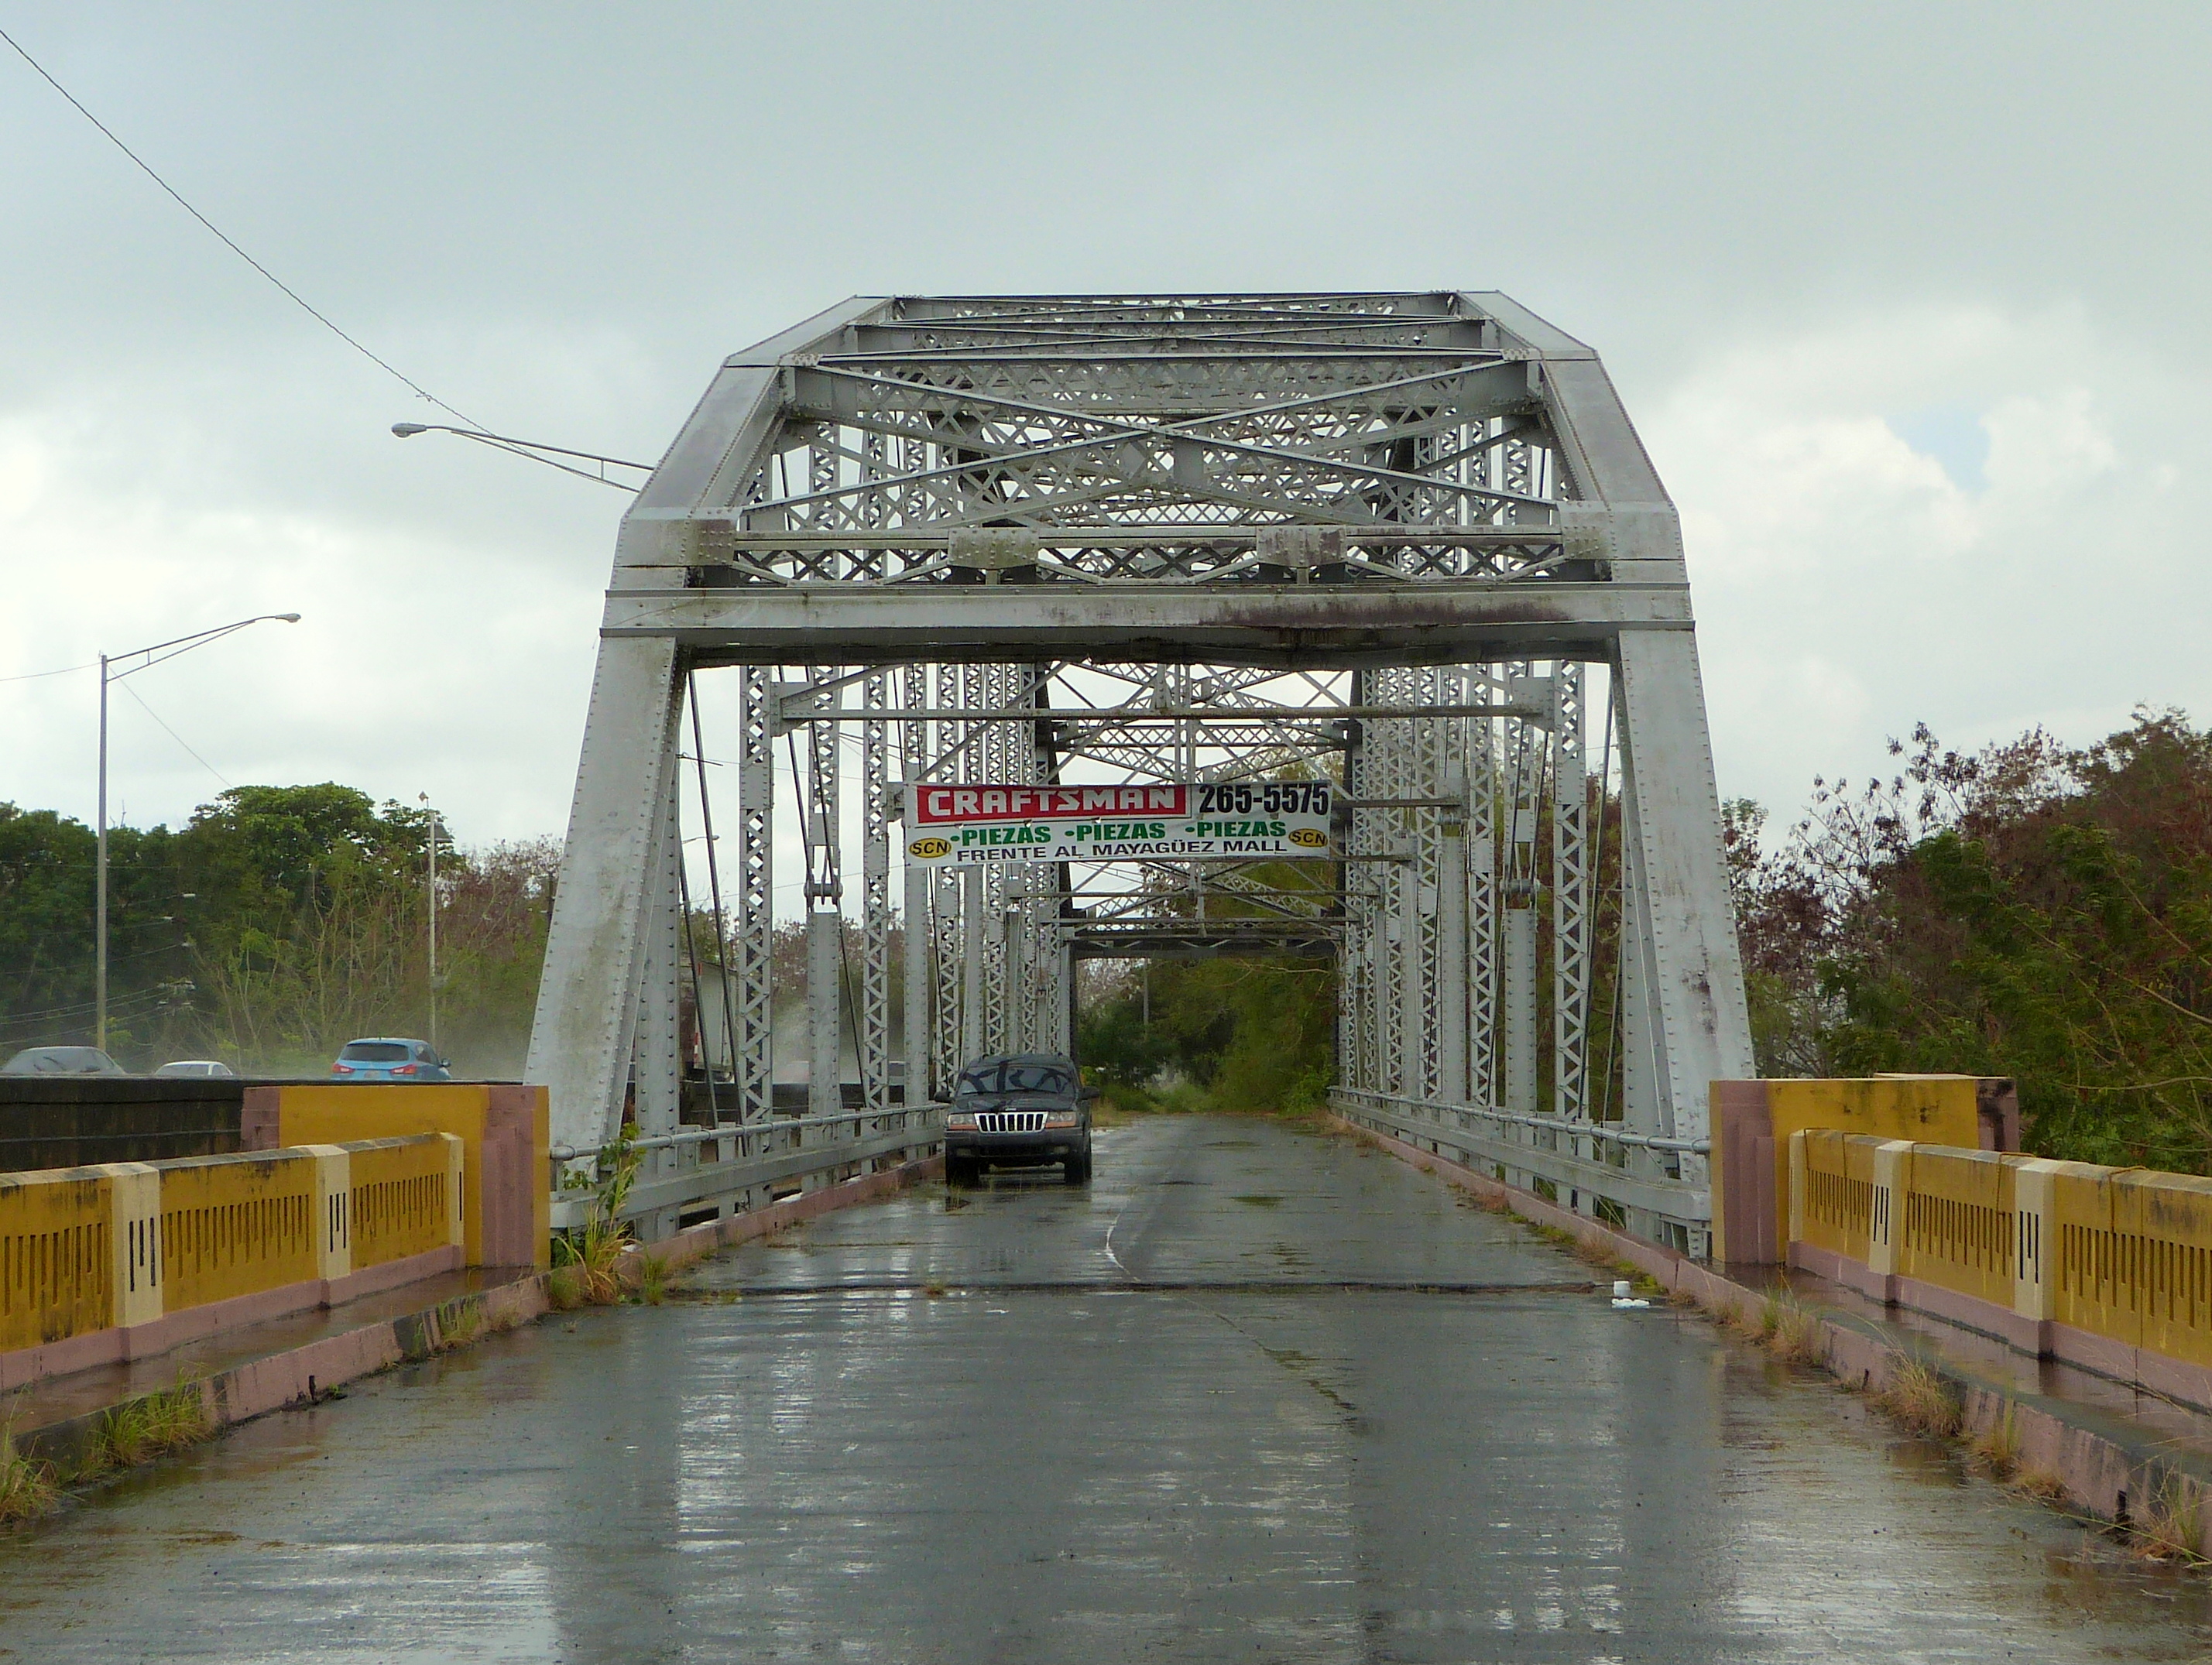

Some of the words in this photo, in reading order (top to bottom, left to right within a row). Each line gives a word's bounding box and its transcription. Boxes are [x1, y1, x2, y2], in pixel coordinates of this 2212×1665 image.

[928, 787, 1175, 816] CRAFTSMAN
[1199, 783, 1329, 815] 265-5575
[911, 841, 948, 855] SCN
[1291, 831, 1326, 845] SCN
[957, 847, 1047, 862] FRENTE
[1055, 845, 1085, 857] AL
[1092, 839, 1215, 856] MAYAGÜEZ
[1224, 841, 1288, 851] MALL
